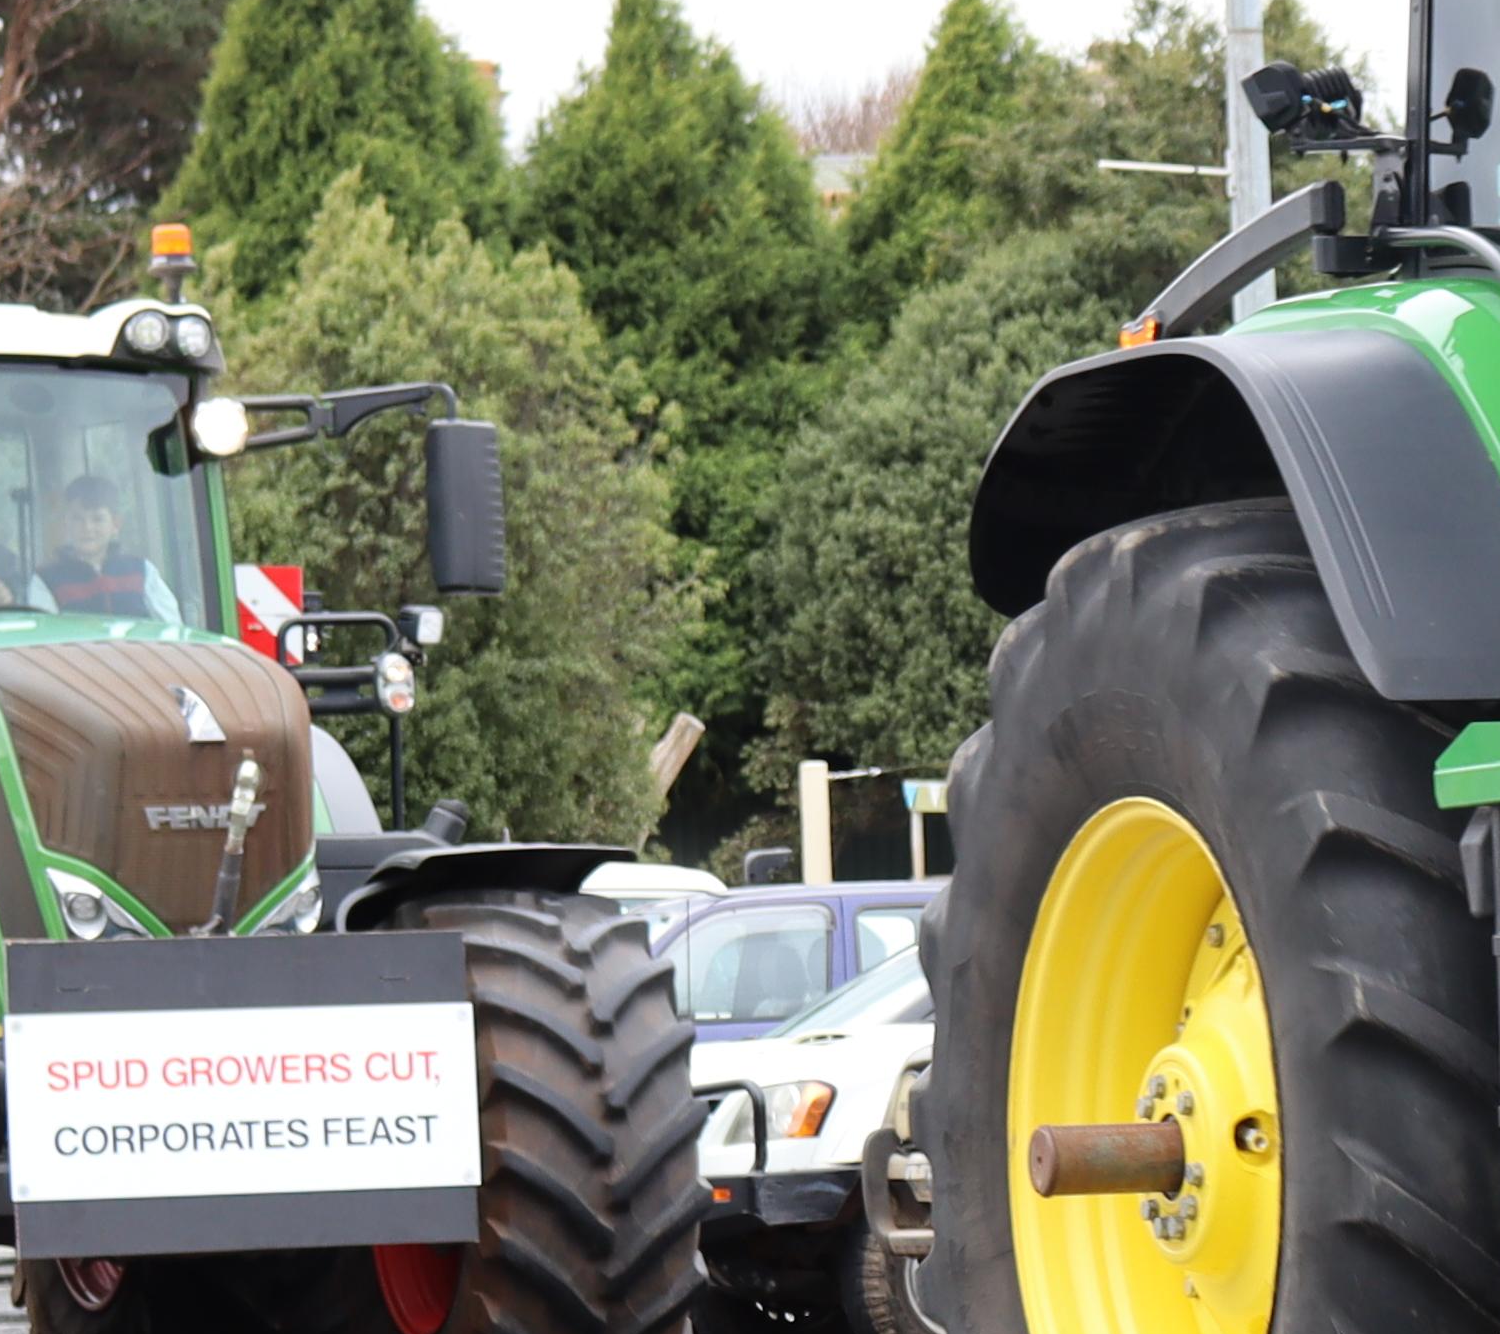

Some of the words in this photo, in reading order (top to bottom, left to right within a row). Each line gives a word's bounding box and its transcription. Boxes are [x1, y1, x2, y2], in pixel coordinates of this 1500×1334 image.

[46, 1059, 149, 1093] SPUD
[162, 1053, 352, 1087] GROWERS
[365, 1051, 442, 1088] CUT,
[54, 1119, 310, 1156] CORPORATES
[323, 1114, 440, 1148] FEAST
